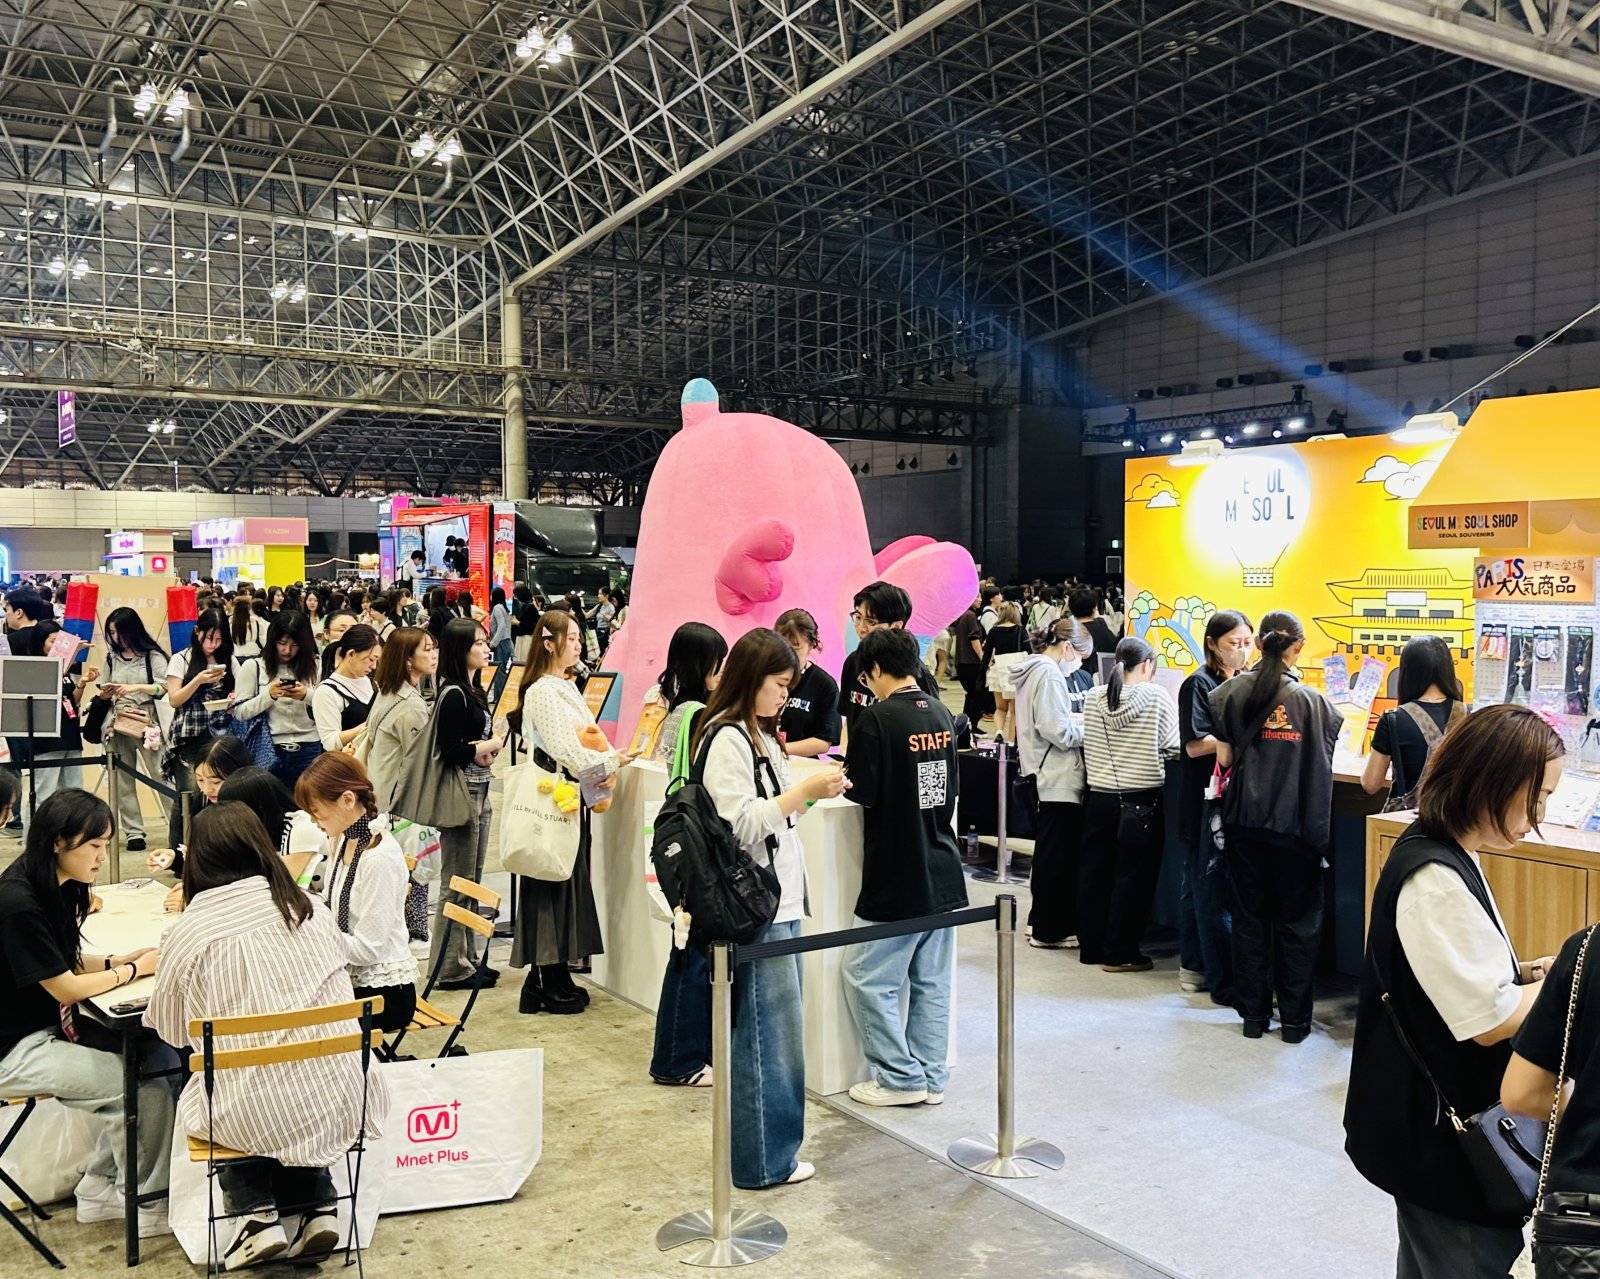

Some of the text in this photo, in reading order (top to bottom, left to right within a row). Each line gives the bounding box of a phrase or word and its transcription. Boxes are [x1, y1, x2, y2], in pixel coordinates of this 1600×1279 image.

[1252, 496, 1294, 521] SOL
[1492, 514, 1518, 528] SHOP
[1475, 558, 1525, 589] PARIS
[1495, 575, 1576, 597] 大人気商品
[908, 730, 952, 752] STAFF
[544, 814, 572, 825] STUART
[396, 1149, 469, 1168] Mnet Plus
